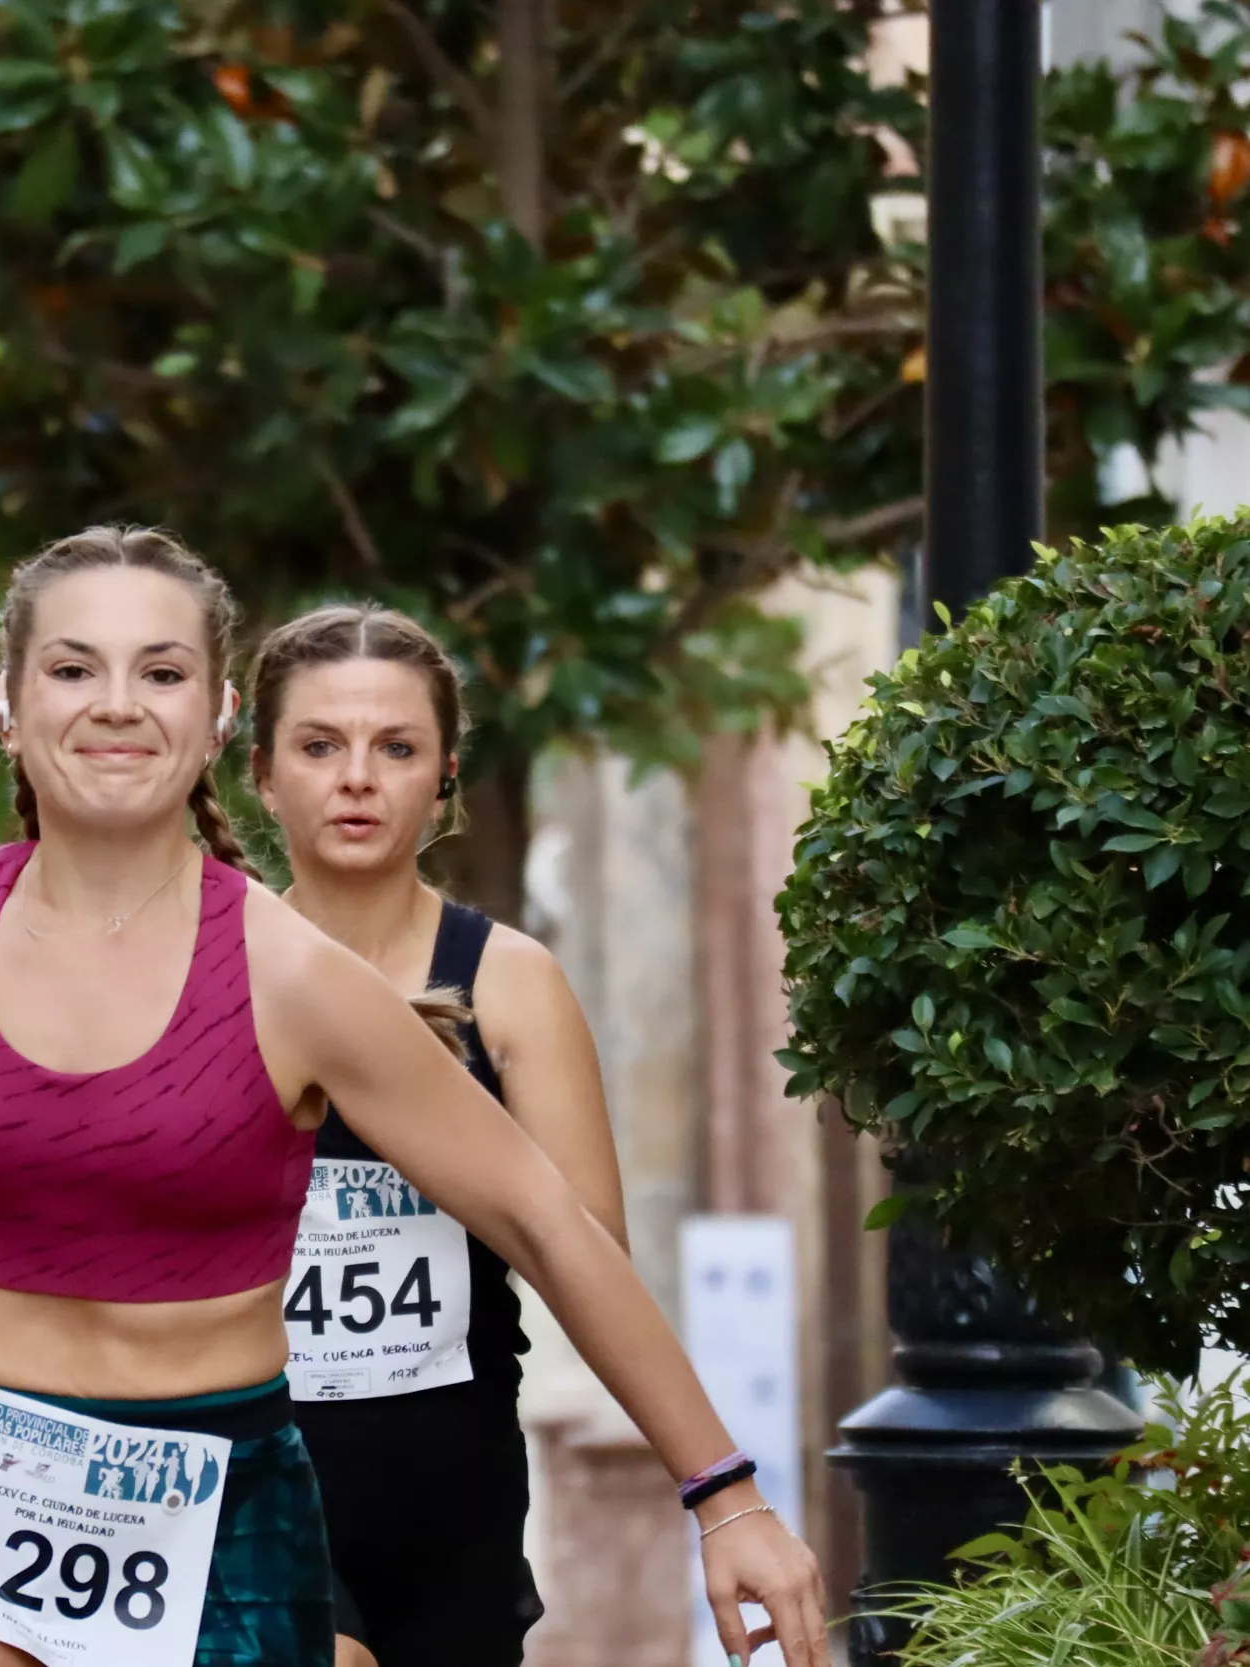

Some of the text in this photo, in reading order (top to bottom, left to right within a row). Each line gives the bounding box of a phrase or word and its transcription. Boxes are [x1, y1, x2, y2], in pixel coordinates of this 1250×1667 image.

[314, 1166, 401, 1190] DE 2024
[308, 1233, 344, 1243] CIUDAD
[346, 1231, 359, 1241] DE
[361, 1227, 401, 1240] LUCENA
[308, 1247, 321, 1257] LA
[324, 1244, 375, 1257] IGUALDAD
[284, 1256, 442, 1336] 454
[323, 1347, 375, 1362] CUENCA
[387, 1367, 419, 1382] 1978
[5, 1406, 70, 1438] PROVINCIAL
[74, 1428, 90, 1442] DE
[13, 1424, 87, 1457] POPULARES
[89, 1432, 165, 1467] 2024
[15, 1507, 115, 1538] POR LA IGUALDAD
[20, 1492, 39, 1506] C.P.
[42, 1498, 83, 1516] CIUDAD
[85, 1508, 100, 1520] DE
[103, 1511, 146, 1526] LUCENA
